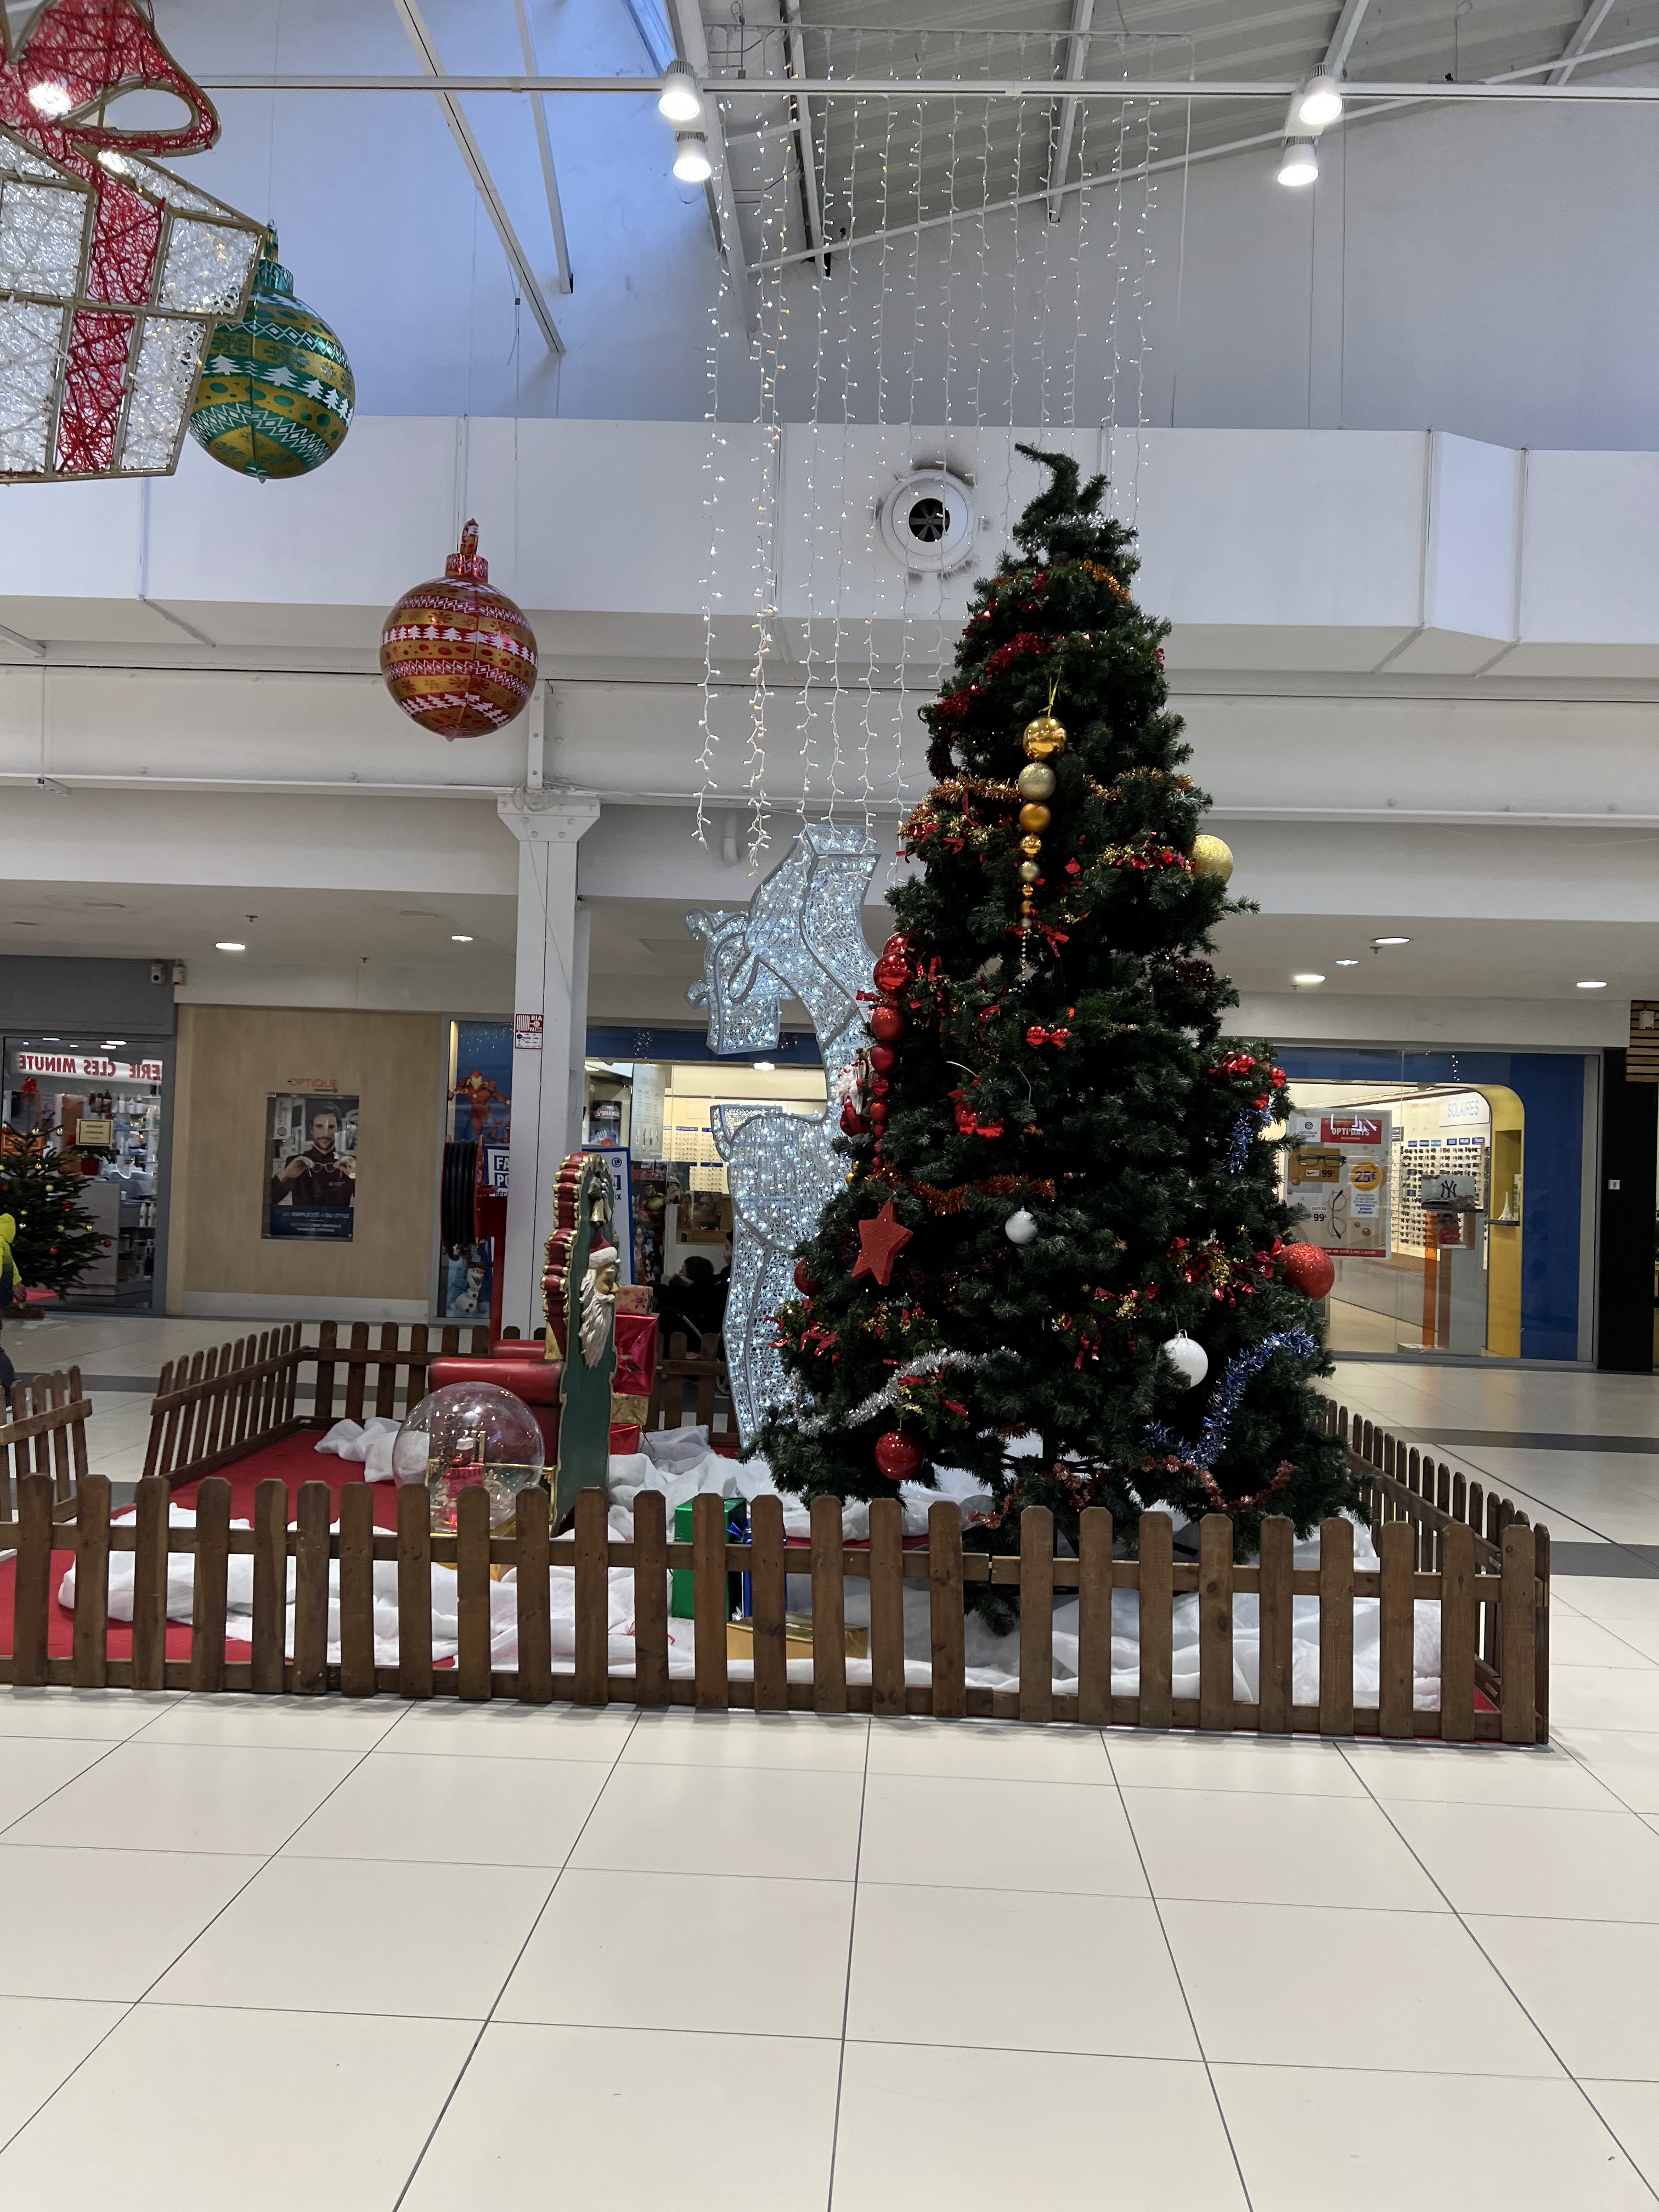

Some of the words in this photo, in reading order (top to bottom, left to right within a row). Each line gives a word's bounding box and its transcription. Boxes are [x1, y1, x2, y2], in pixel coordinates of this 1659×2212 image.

[289, 1077, 338, 1088] OPTIQUE
[1448, 1100, 1479, 1118] SOLAIRES
[1355, 1171, 1377, 1183] 25€
